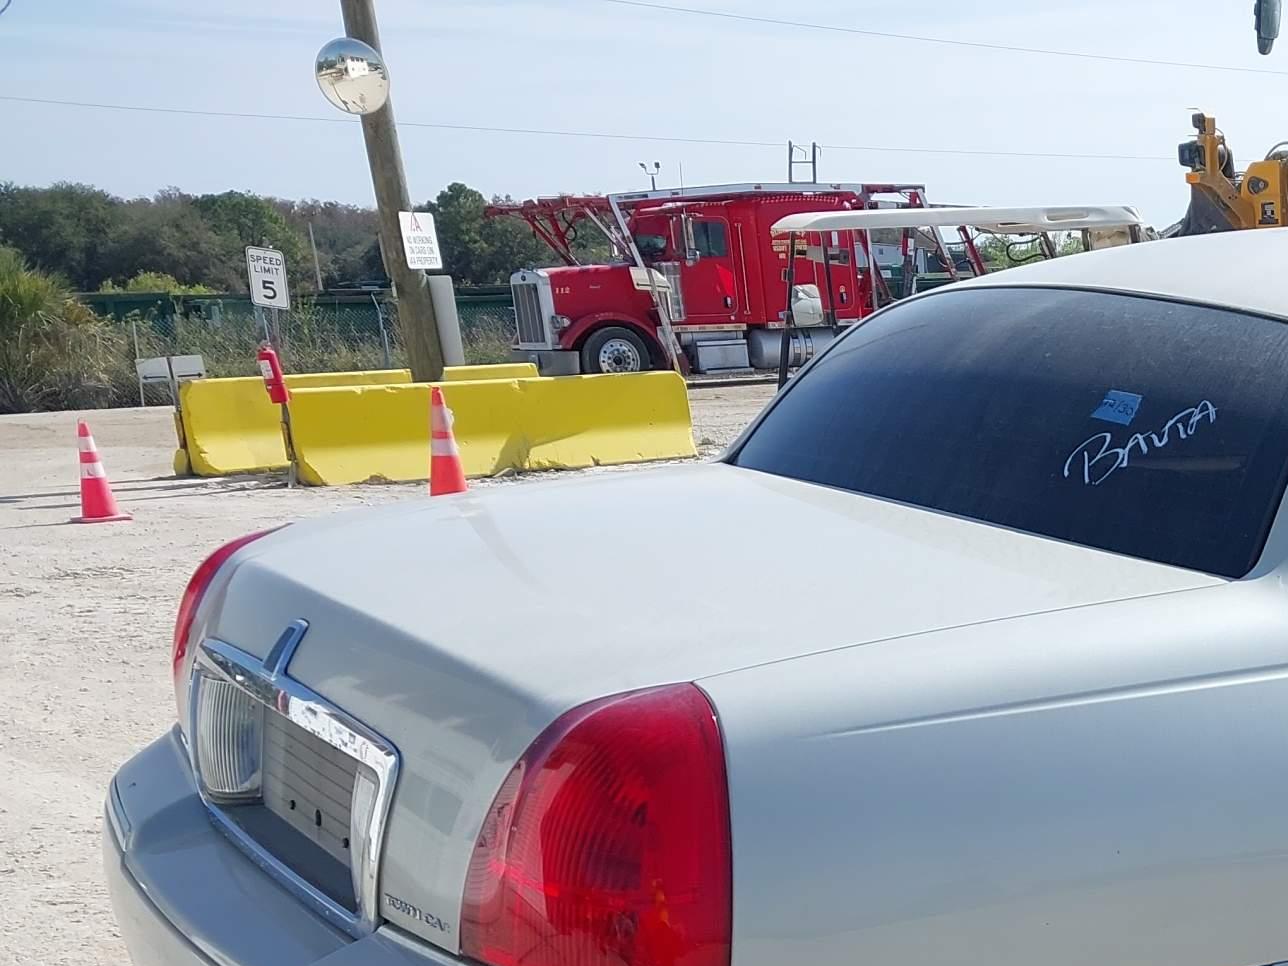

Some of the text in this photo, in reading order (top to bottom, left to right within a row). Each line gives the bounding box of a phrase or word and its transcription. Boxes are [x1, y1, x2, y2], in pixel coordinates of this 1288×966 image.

[250, 254, 282, 267] SPEED
[253, 263, 280, 276] LIMIT
[262, 279, 277, 300] 5
